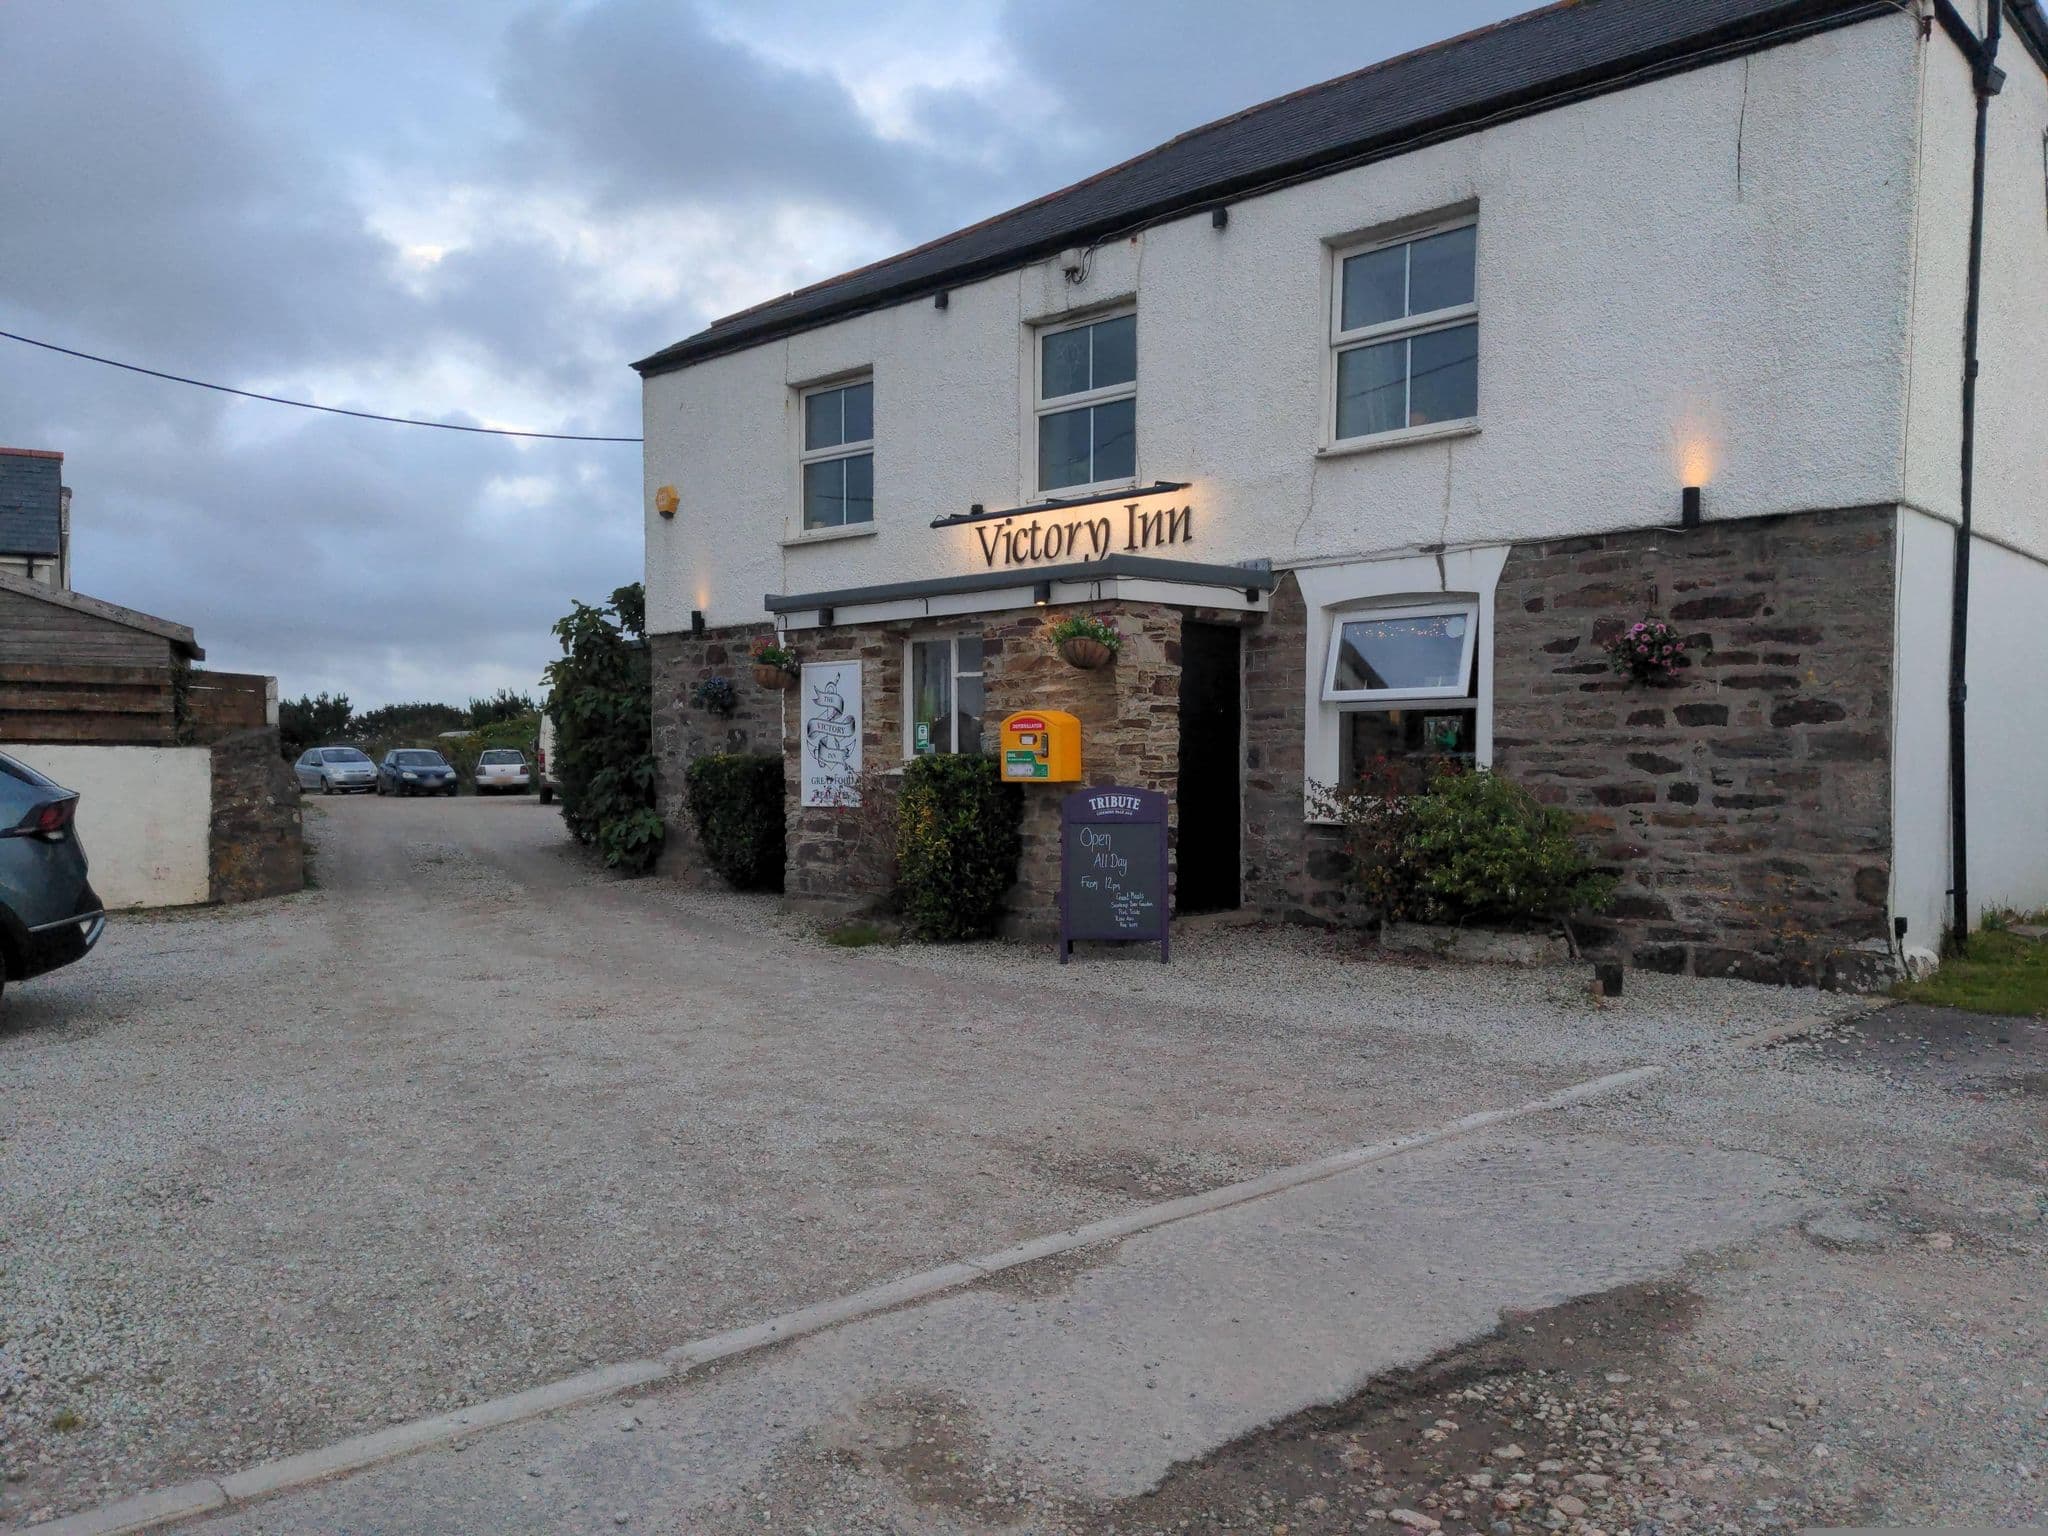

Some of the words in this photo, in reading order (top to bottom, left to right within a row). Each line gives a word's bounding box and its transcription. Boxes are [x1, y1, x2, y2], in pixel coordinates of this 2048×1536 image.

[975, 517, 1111, 567] Victory
[1123, 503, 1193, 551] Inn
[817, 722, 846, 734] VICTORY
[1088, 795, 1141, 810] TRIBUTE
[1080, 827, 1111, 852] Open
[1094, 853, 1108, 868] All
[1110, 853, 1127, 877] Day
[1081, 875, 1098, 890] From
[1105, 876, 1121, 892] 12pm
